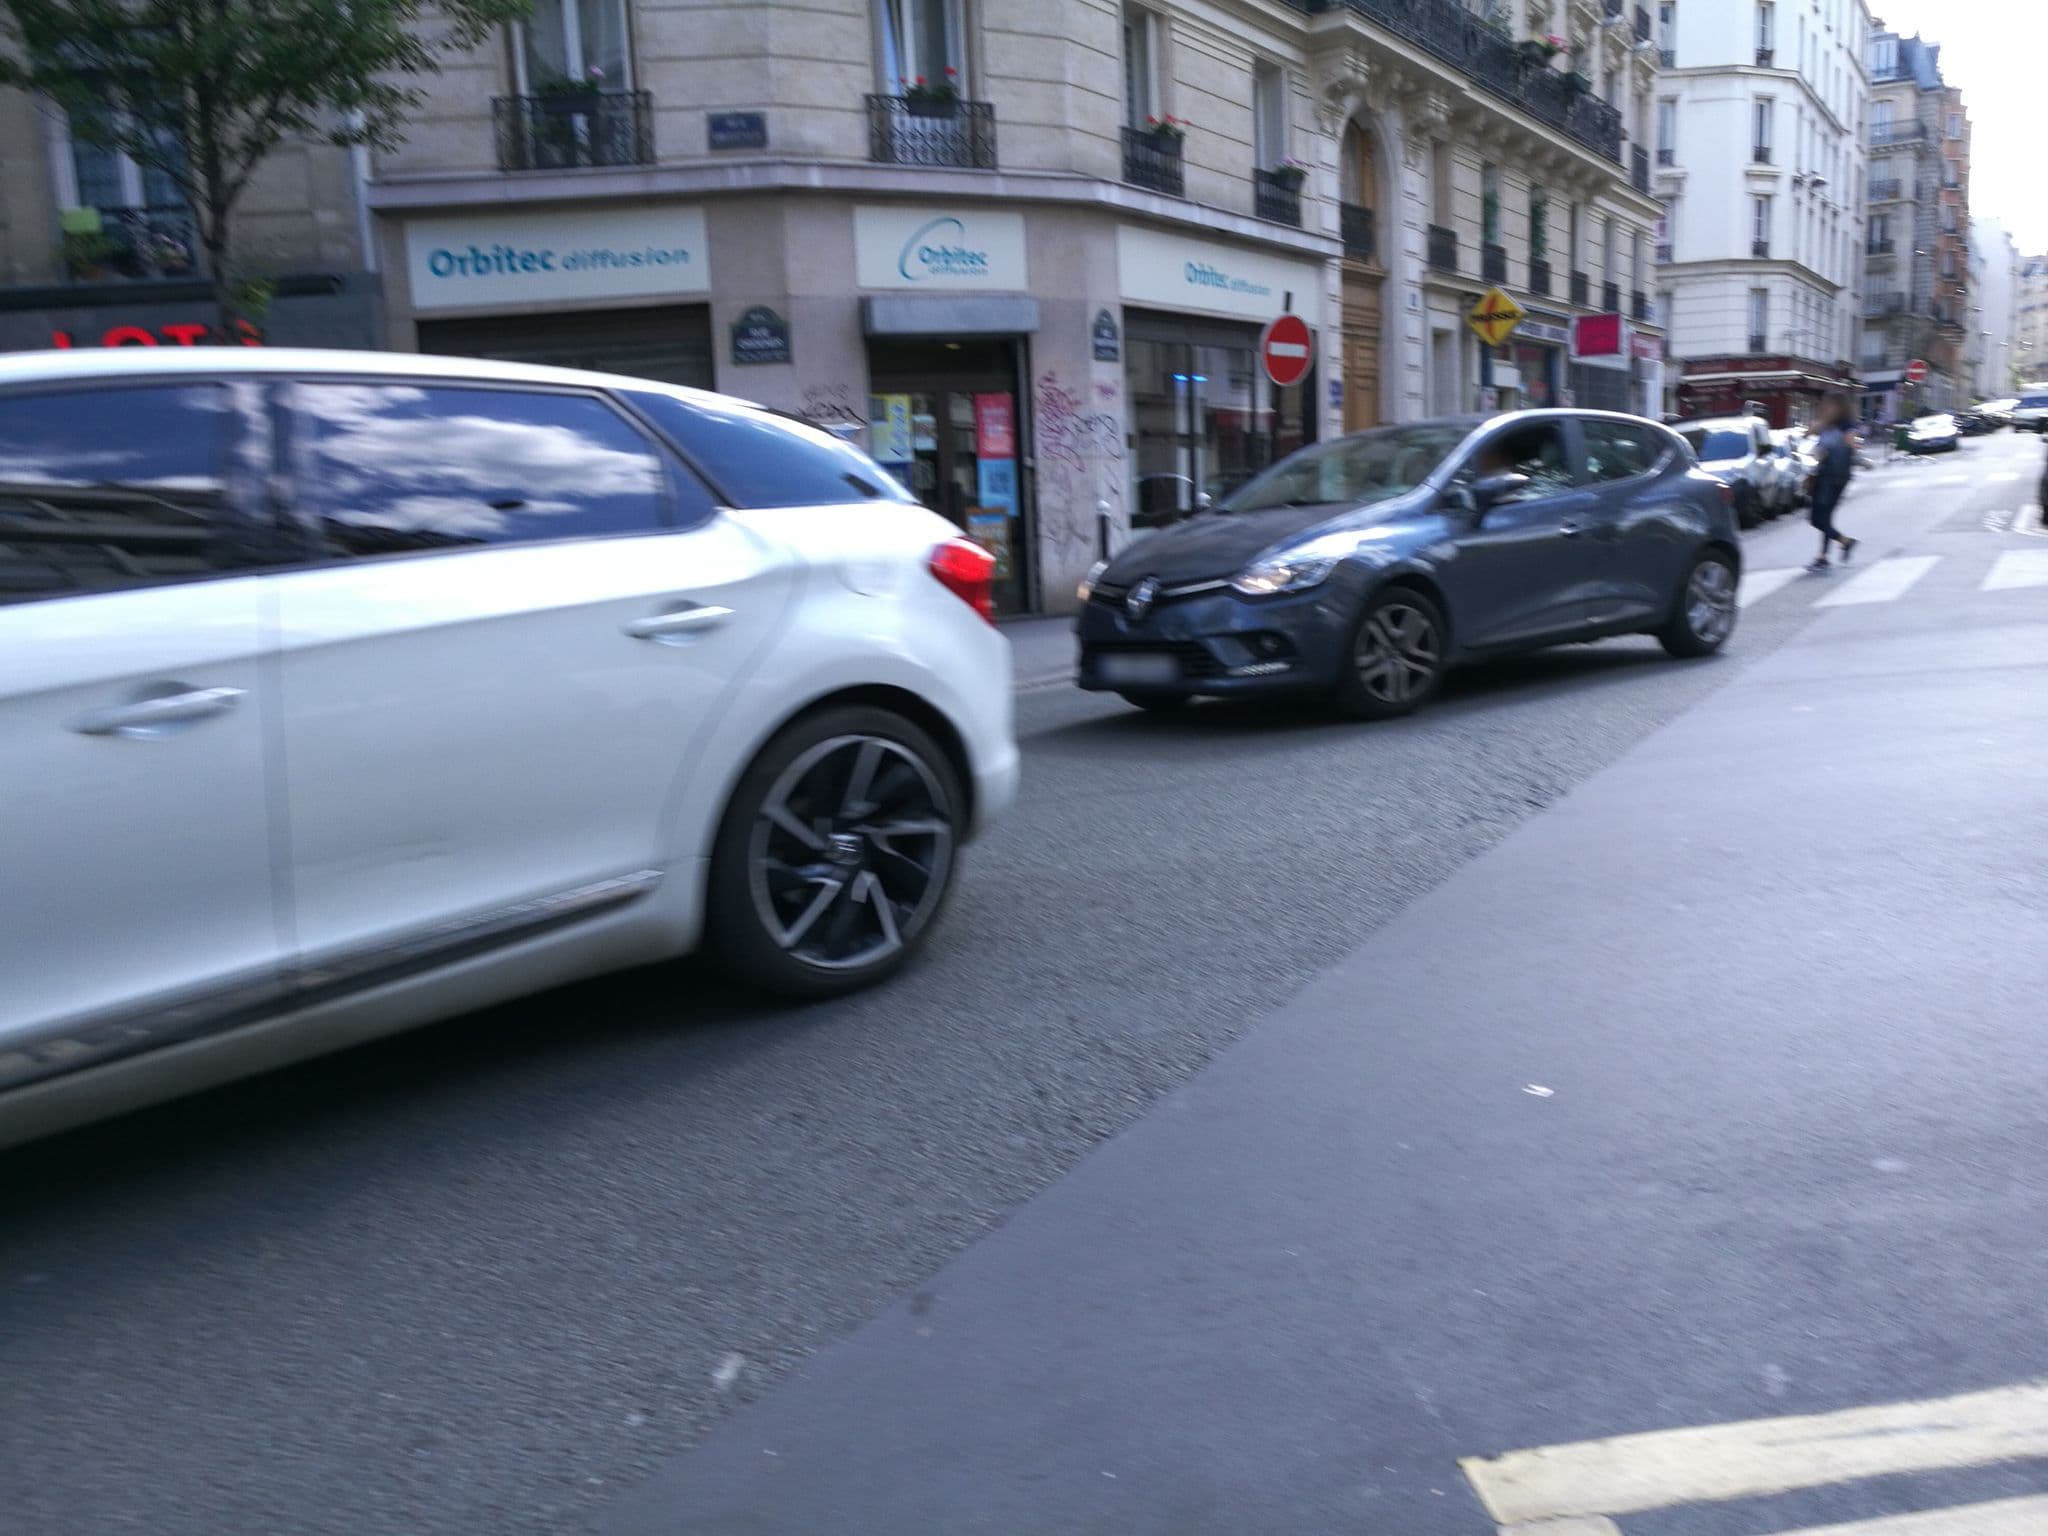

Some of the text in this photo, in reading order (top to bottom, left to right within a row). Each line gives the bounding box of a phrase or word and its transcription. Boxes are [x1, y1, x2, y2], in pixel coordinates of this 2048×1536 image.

[428, 244, 690, 278] Orbitec diffusion
[918, 245, 989, 266] Orbitec
[1184, 261, 1230, 288] Orbitec
